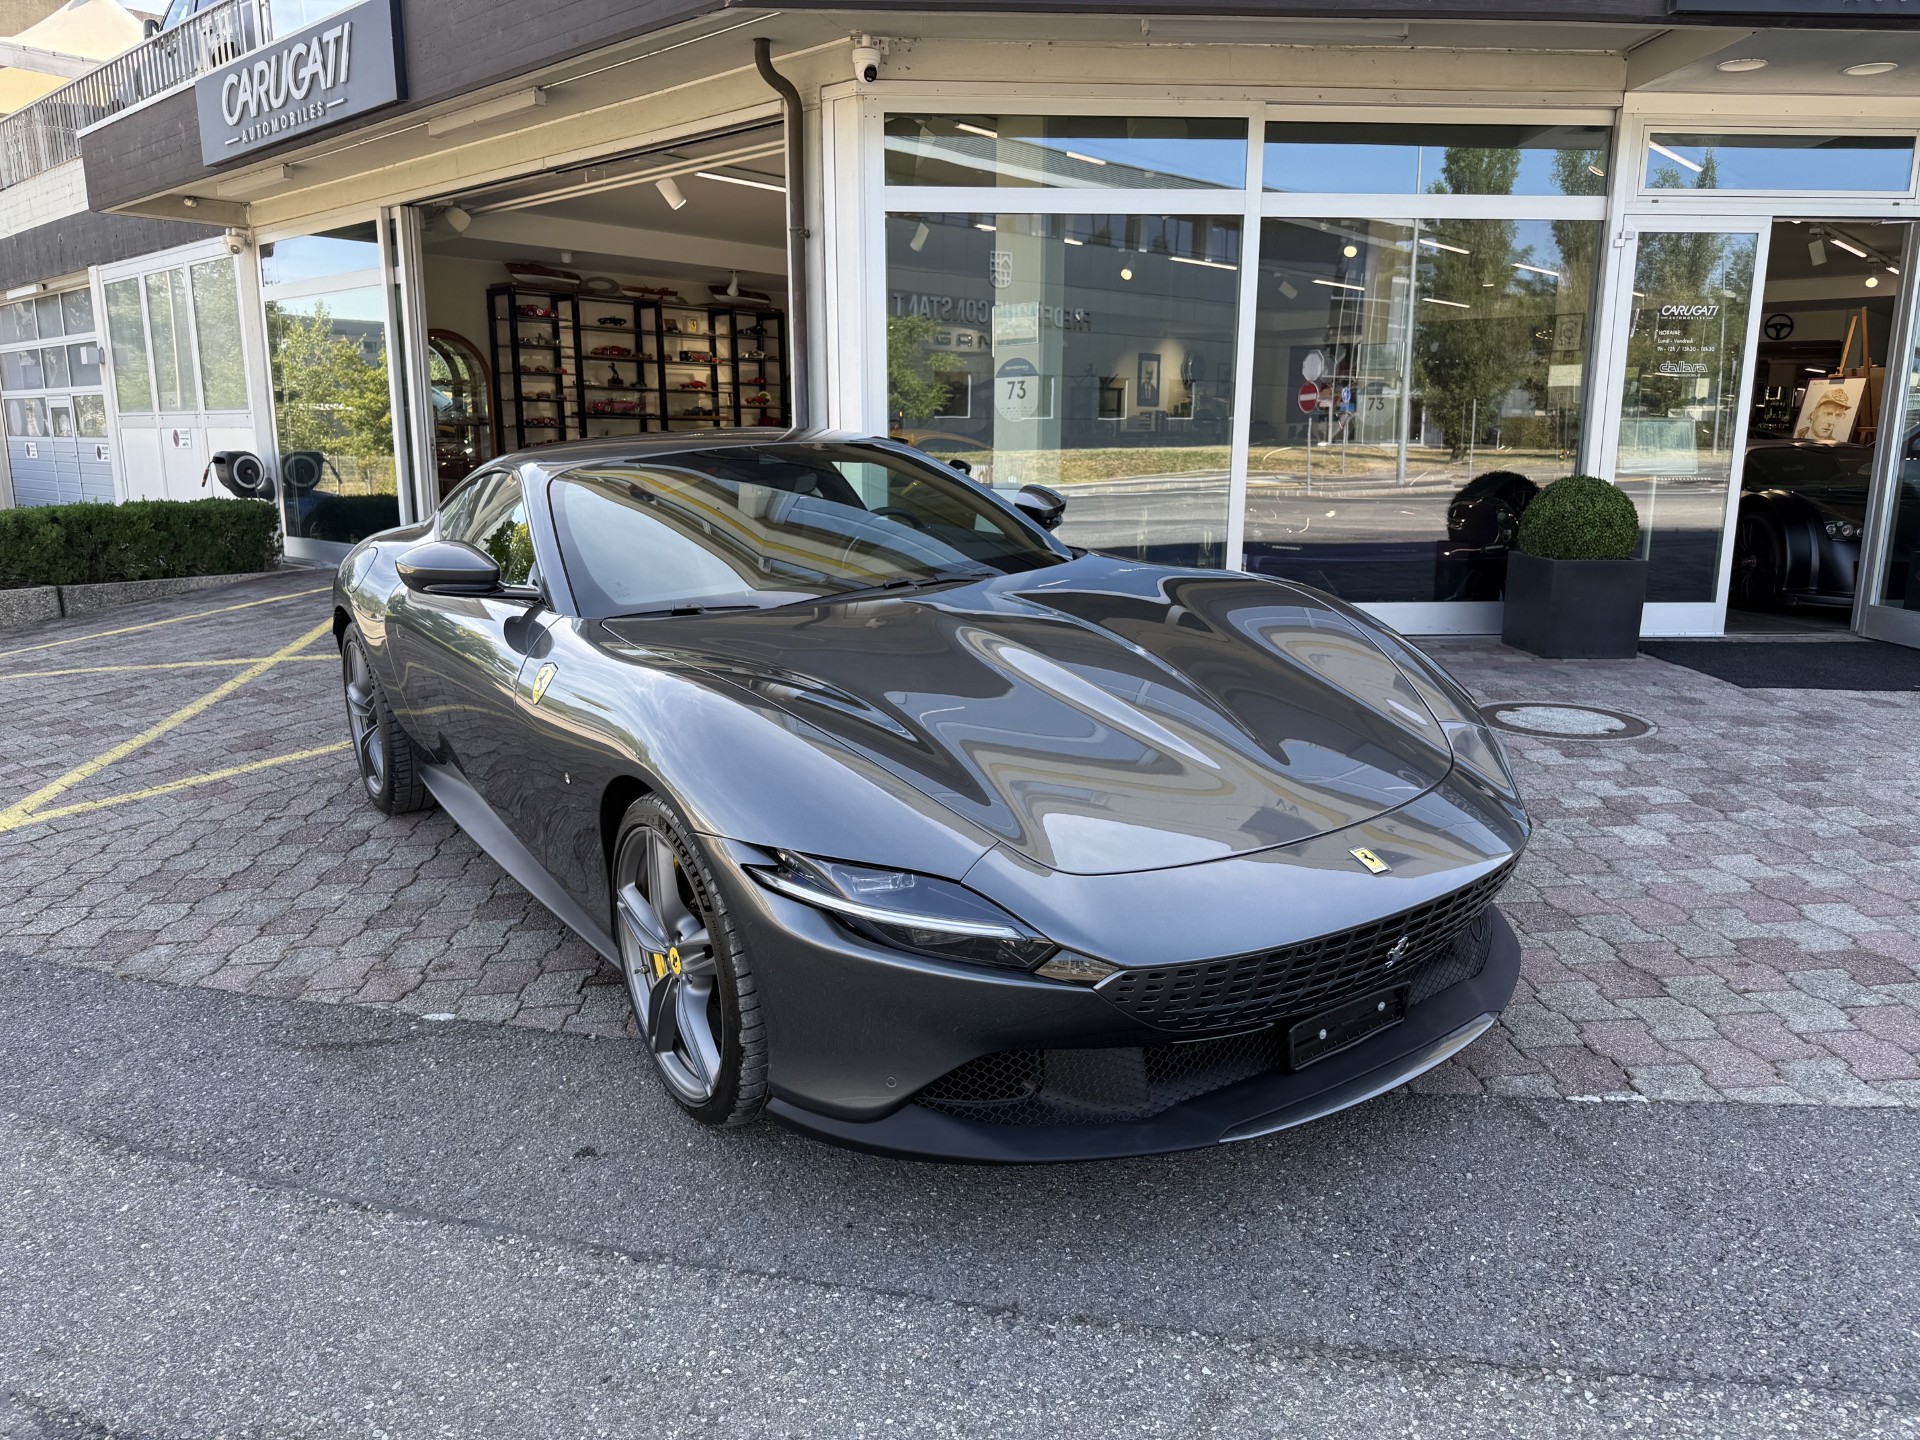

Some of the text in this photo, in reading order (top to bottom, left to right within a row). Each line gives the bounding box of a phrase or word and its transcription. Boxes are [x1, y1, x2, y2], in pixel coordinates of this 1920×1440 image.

[221, 21, 352, 126] CARUGATI
[242, 101, 325, 144] AUTOMOBILES
[1661, 304, 1719, 316] CARUGATI
[1660, 361, 1708, 373] dallara
[1007, 380, 1027, 400] 73
[1368, 397, 1385, 411] 73
[667, 830, 711, 907] MICHELIN
